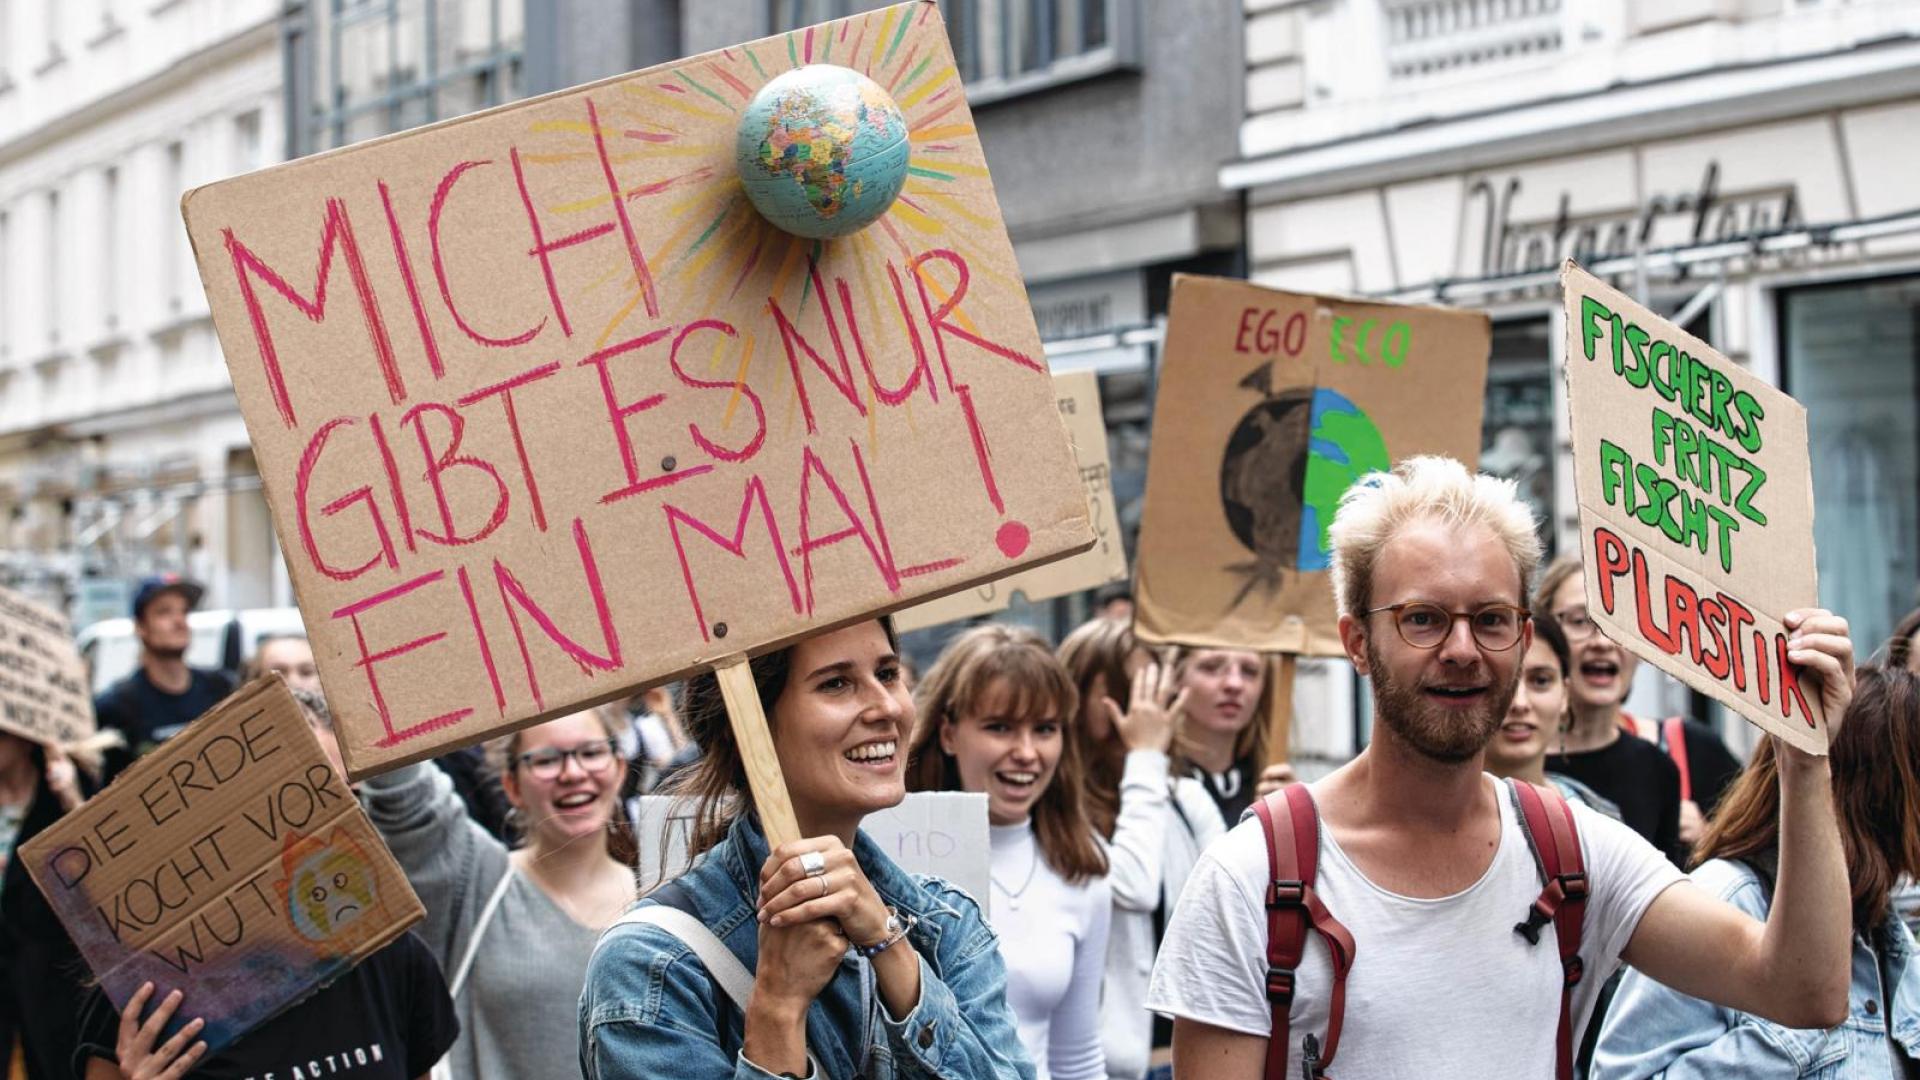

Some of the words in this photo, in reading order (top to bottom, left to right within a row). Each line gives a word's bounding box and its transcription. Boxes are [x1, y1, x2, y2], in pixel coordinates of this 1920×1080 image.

[221, 98, 660, 429] MICH
[1234, 307, 1307, 357] EGO
[1330, 315, 1412, 368] ECO
[294, 361, 560, 581] GIBT
[578, 319, 767, 503] ES
[765, 248, 1043, 434] NUR
[1581, 295, 1764, 453] FISCHERS
[1600, 439, 1740, 574] FISCHT
[1652, 406, 1767, 526] FRITZ
[331, 517, 625, 748] EIN
[1594, 527, 1816, 729] PLASTIK
[50, 809, 139, 890] DIE
[138, 708, 282, 826] ERDE
[97, 826, 232, 944] KOCHT
[242, 763, 342, 842] VOR
[150, 869, 277, 974] WUT
[292, 1044, 383, 1080] ACTION
